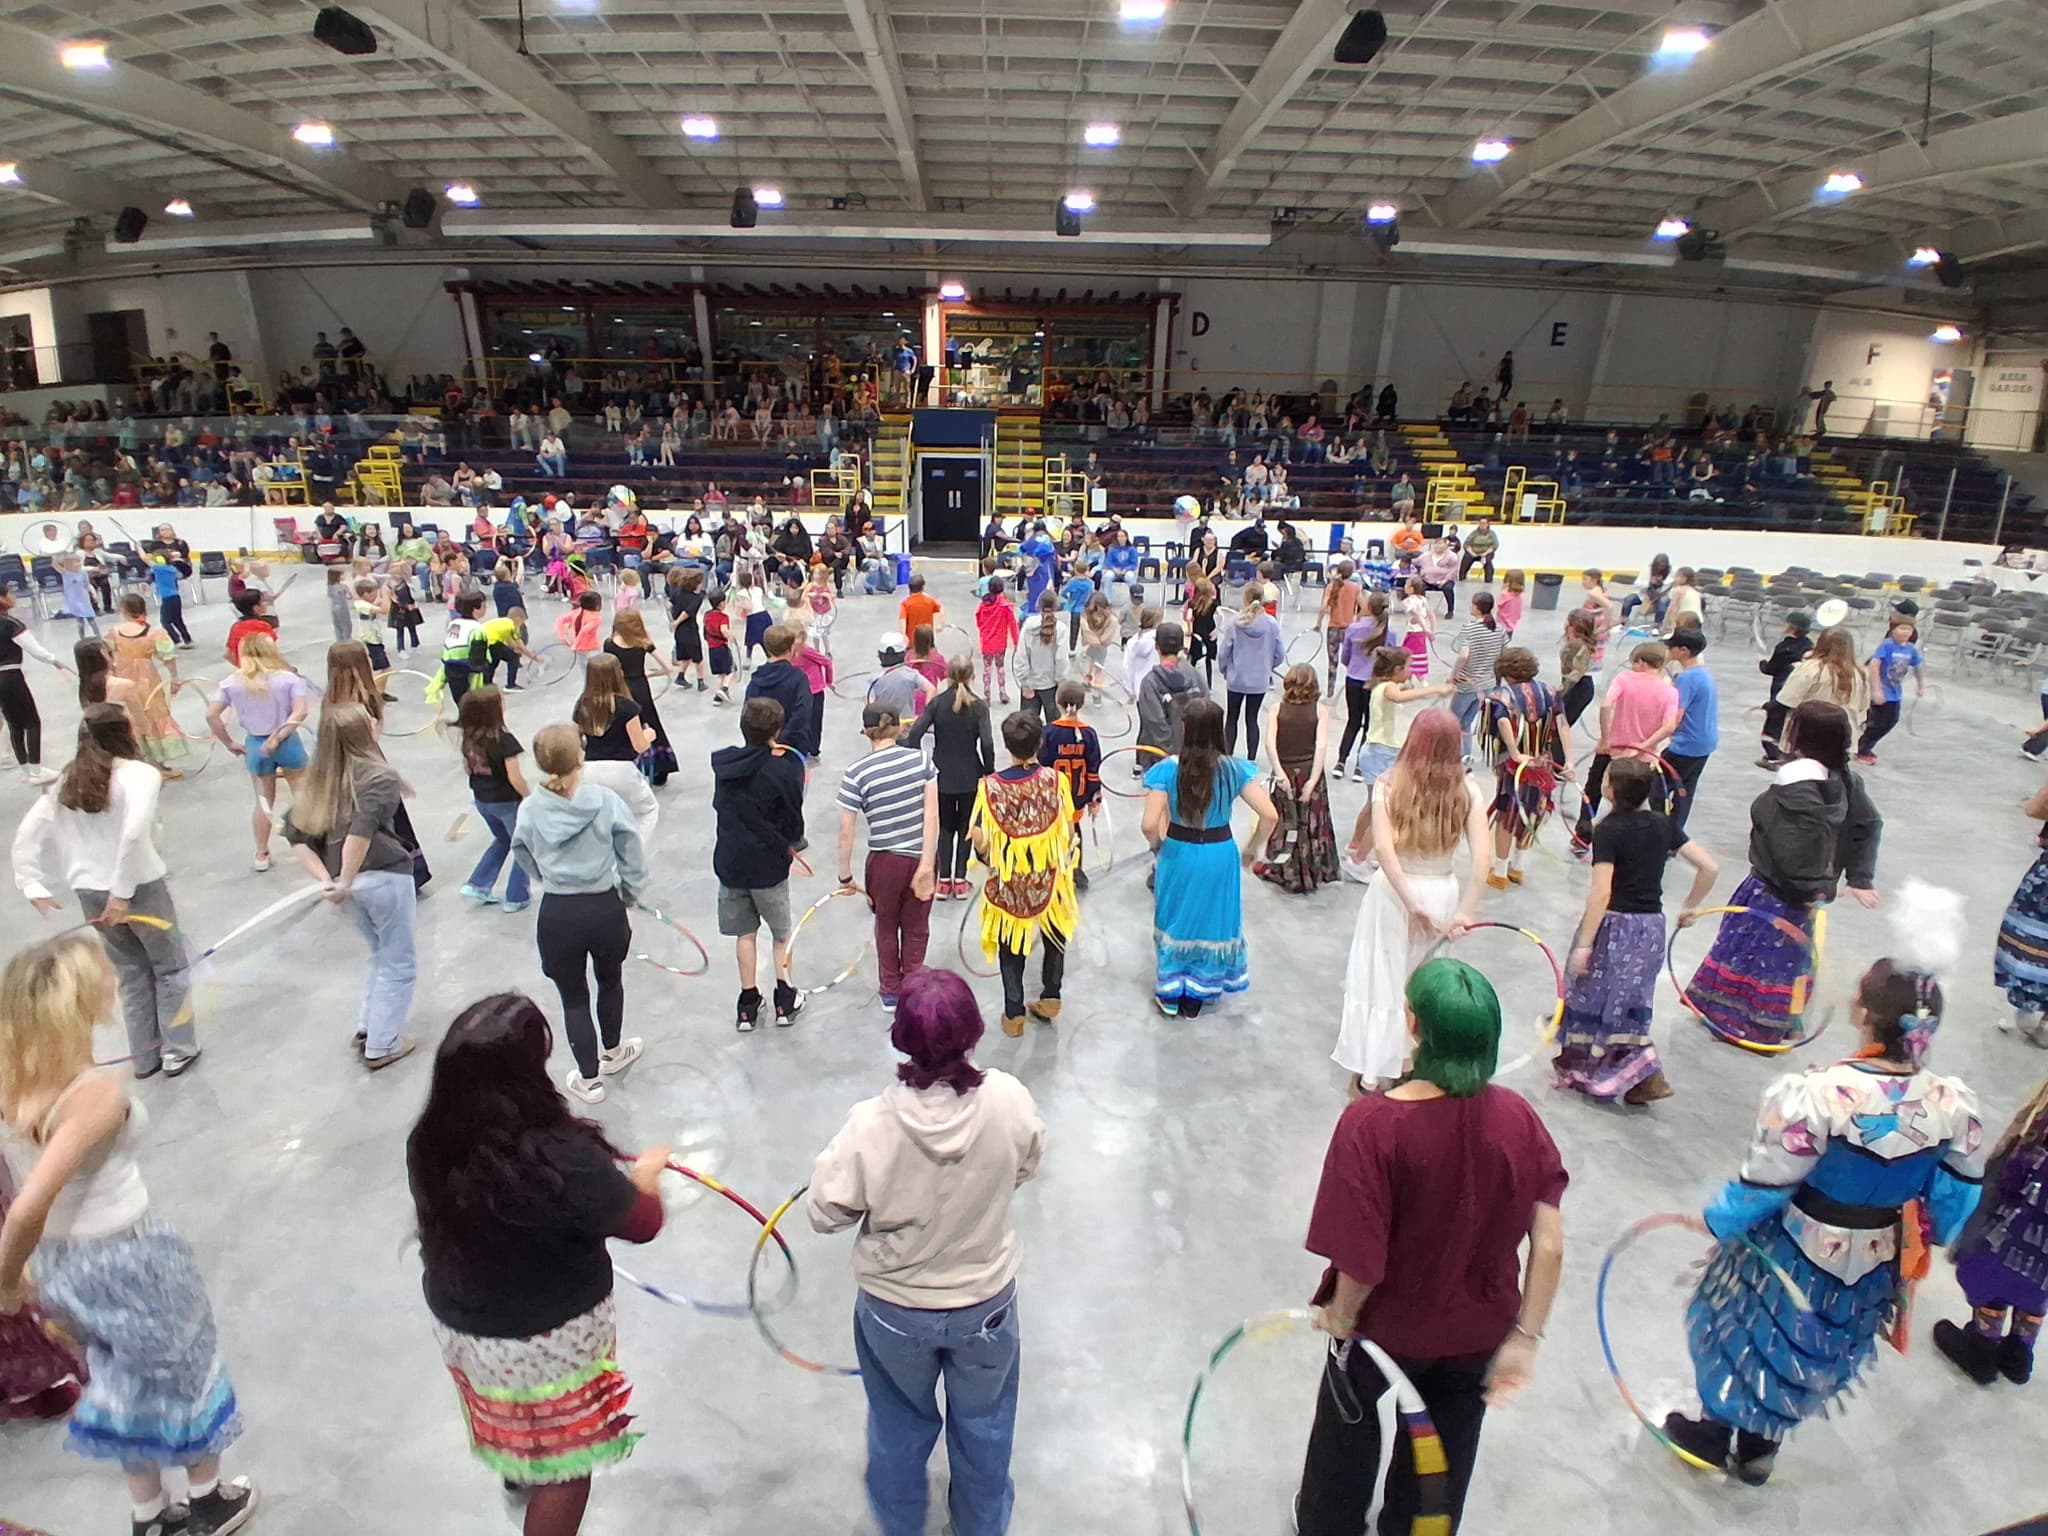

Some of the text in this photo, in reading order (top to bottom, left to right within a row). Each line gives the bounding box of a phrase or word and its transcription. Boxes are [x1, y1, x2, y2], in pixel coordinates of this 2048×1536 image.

[1192, 312, 1210, 337] D
[1551, 322, 1569, 346] E
[1867, 343, 1882, 365] F
